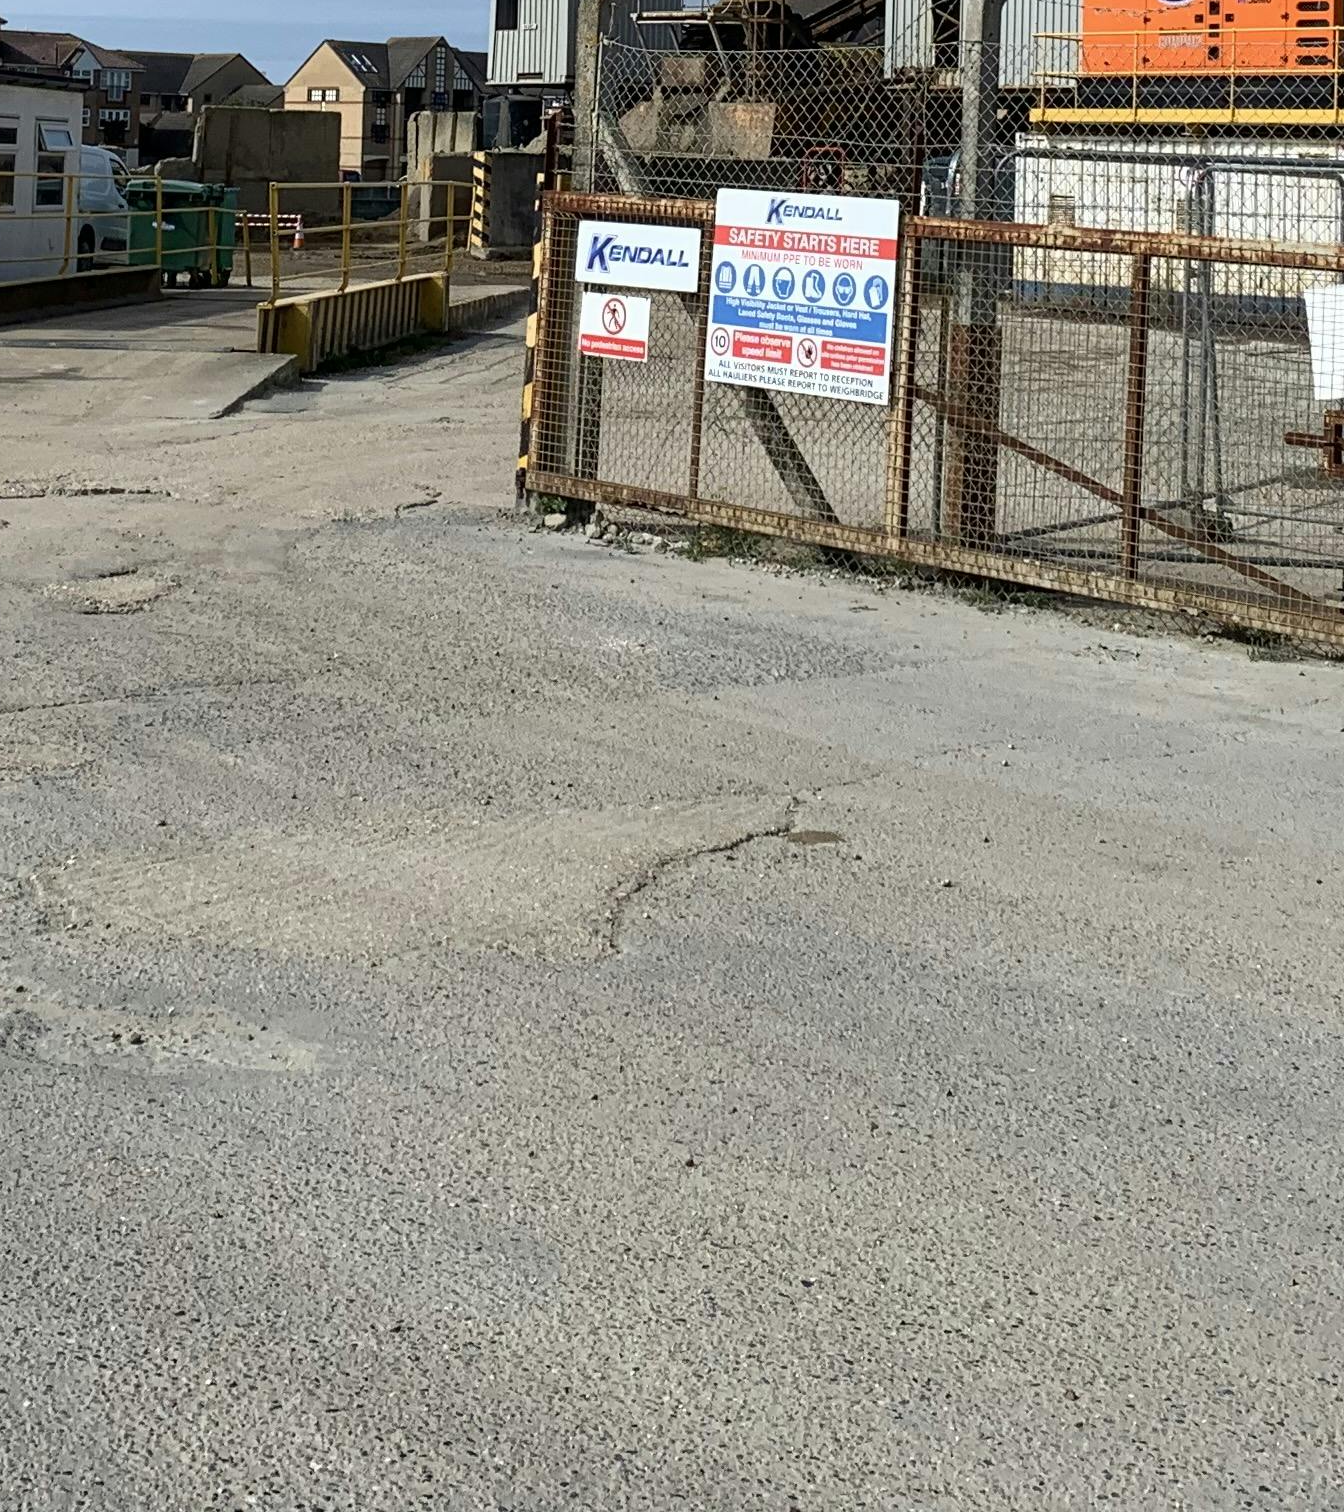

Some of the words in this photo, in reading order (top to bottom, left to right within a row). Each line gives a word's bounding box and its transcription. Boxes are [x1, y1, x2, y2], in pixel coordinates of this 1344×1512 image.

[765, 197, 843, 225] KENDALL
[729, 228, 782, 248] SAFETY
[783, 232, 837, 252] STARTS
[840, 238, 880, 256] HERE
[586, 234, 689, 274] KENDALL
[742, 250, 781, 262] MINIMUM
[783, 254, 800, 265] PPE
[804, 256, 815, 266] TO
[819, 257, 830, 267] BE
[834, 259, 863, 270] WORN
[726, 297, 740, 307] High
[741, 298, 766, 310] Visibility
[767, 302, 786, 311] Jacket
[757, 310, 775, 321] Safety
[835, 319, 857, 329] Gloves
[582, 338, 591, 347] No
[715, 335, 726, 348] 10
[735, 332, 759, 343] Please
[760, 336, 791, 348] observe
[742, 346, 765, 357] speed
[719, 360, 730, 368] ALL
[734, 362, 765, 373] VISITORS
[767, 366, 788, 375] MUST
[790, 369, 817, 380] REPORT
[820, 373, 829, 382] TO
[832, 375, 873, 387] RECEPTION
[708, 369, 720, 377] ALL
[723, 371, 757, 382] HAULIERS
[759, 376, 786, 386] PLEASE
[788, 379, 815, 389] REPORT
[818, 384, 828, 392] TO
[830, 386, 884, 400] WEIGHBRIDGE
